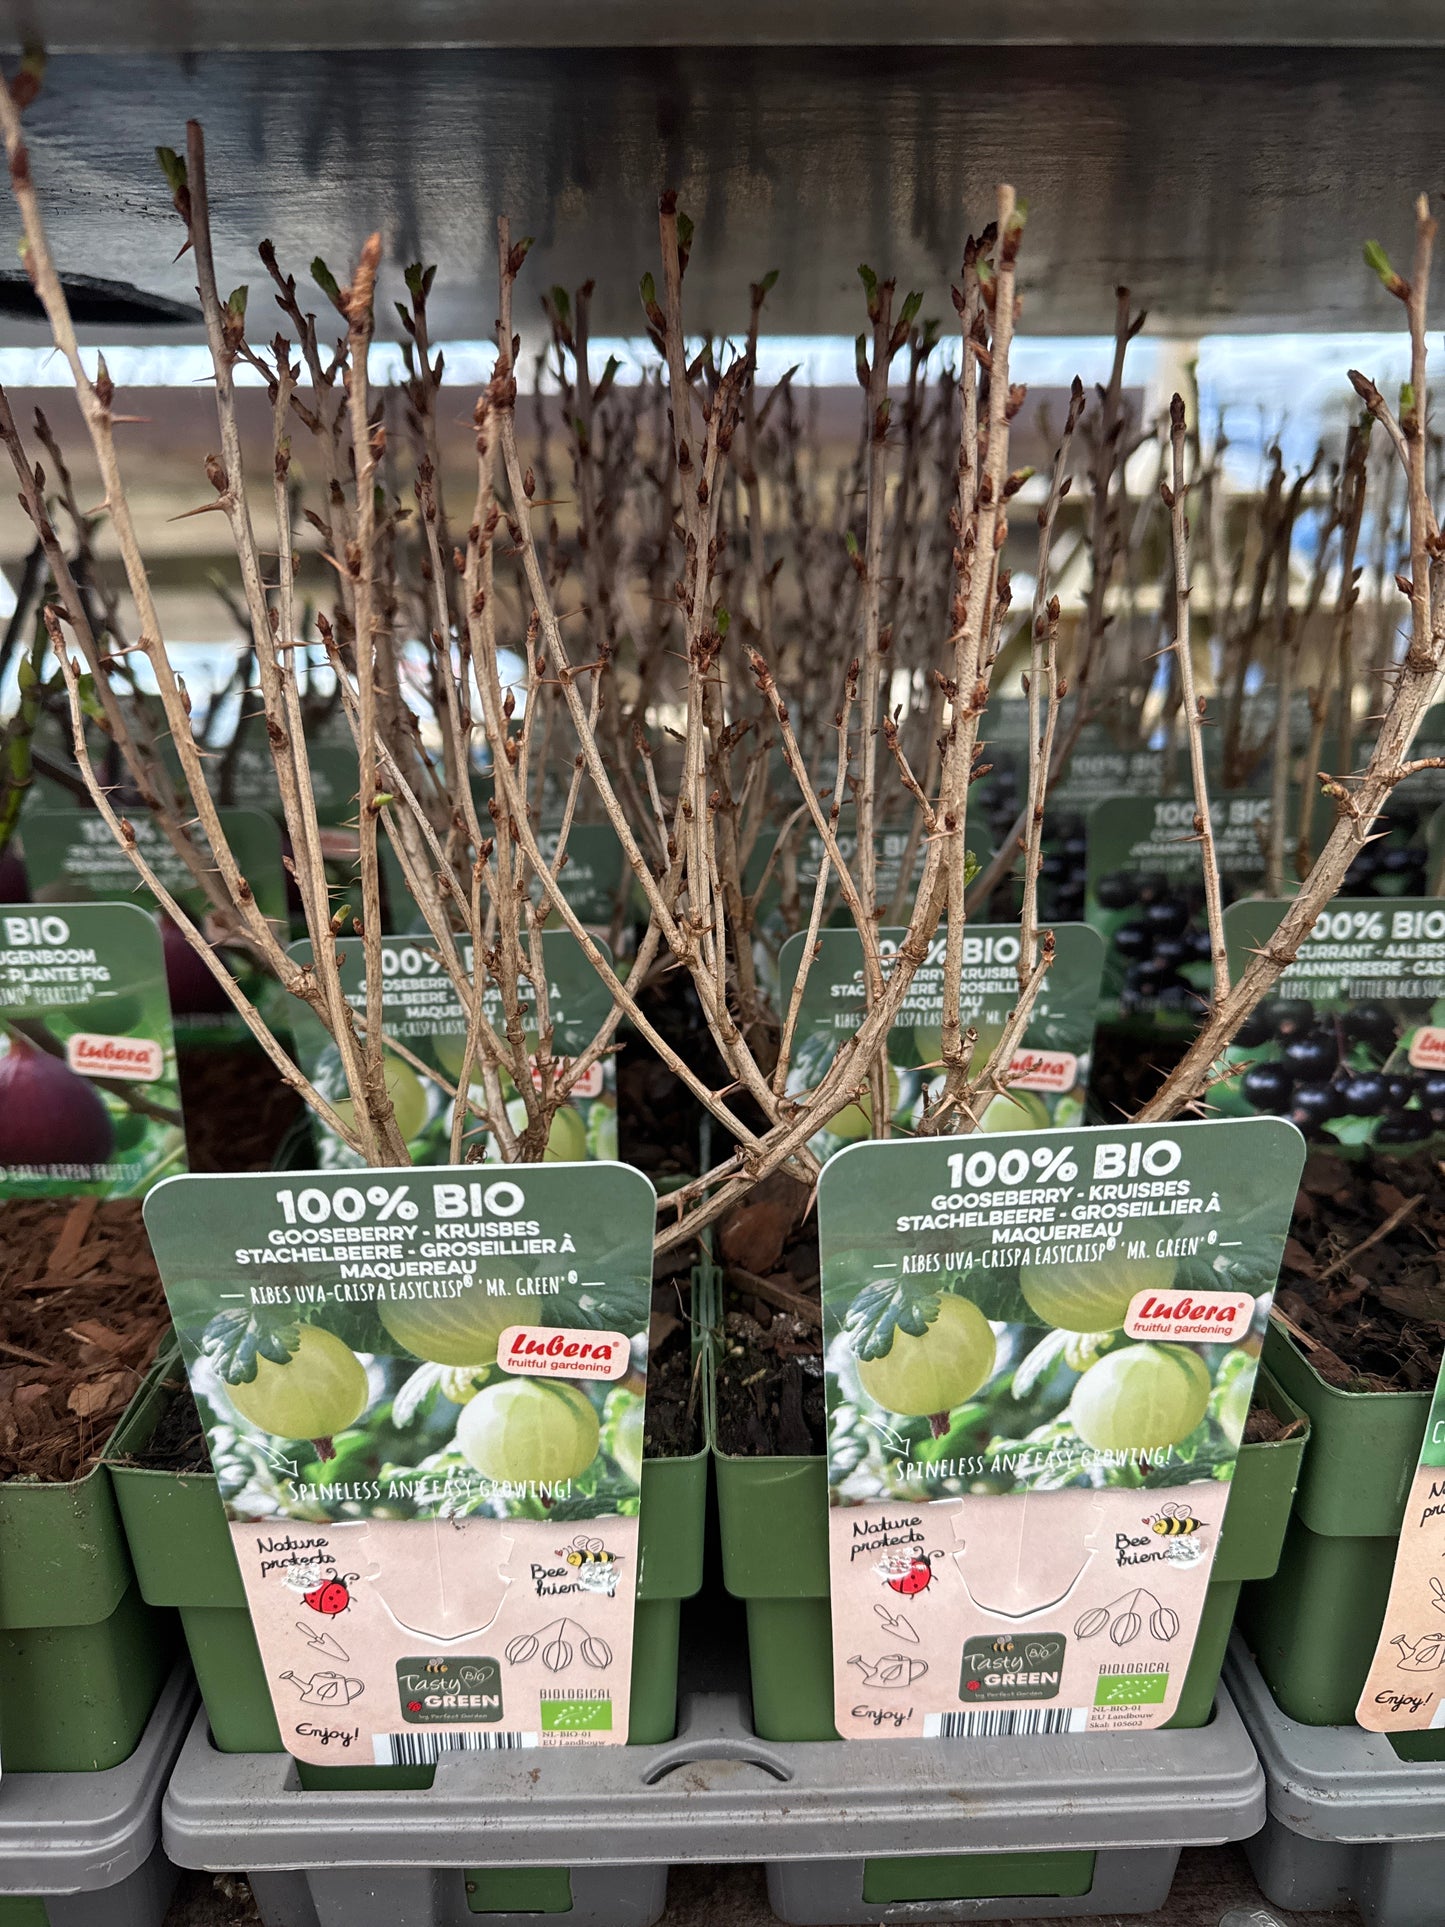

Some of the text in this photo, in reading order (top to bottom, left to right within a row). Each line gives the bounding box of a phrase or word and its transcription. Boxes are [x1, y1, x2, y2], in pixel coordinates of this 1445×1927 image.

[4, 915, 71, 946] BIO
[8, 966, 80, 983] PLANTE
[79, 966, 112, 982] FIG
[946, 1139, 1183, 1189] 100% BIO
[276, 1181, 525, 1224] 100% BIO
[931, 1187, 1073, 1211] GOOSEBERRY
[1088, 1180, 1190, 1201] KRUISBES
[896, 1206, 1055, 1232] STACHELBEERE
[1071, 1198, 1204, 1224] GROSEILLIER
[1204, 1191, 1221, 1213] À
[268, 1224, 419, 1246] GOOSEBERRY
[435, 1220, 540, 1239] KRUISBES
[992, 1221, 1123, 1245] MAQUEREAU
[235, 1243, 403, 1265] STACHELBEERE
[419, 1238, 557, 1259] GROSEILLIER
[559, 1232, 576, 1253] À
[901, 1253, 940, 1274] RIBES
[945, 1244, 1031, 1272] UVA-CRISPA
[340, 1259, 477, 1281] MAQUEREAU
[249, 1285, 291, 1305] RIBES
[295, 1281, 387, 1304] UVA-CRISPA
[1132, 1321, 1233, 1336] fruitful gardening
[507, 1357, 612, 1374] fruitful gardening
[852, 1514, 922, 1538] Nature
[257, 1535, 329, 1554] Nature
[1115, 1533, 1151, 1550] Bee
[530, 1563, 568, 1580] Bee
[964, 1653, 1024, 1674] Tasty
[1099, 1662, 1171, 1675] BIOLOGICAL
[400, 1673, 461, 1696] Tasty
[984, 1671, 1058, 1686] GREEN
[424, 1694, 499, 1708] GREEN
[539, 1688, 612, 1699] BIOLOGICAL
[1374, 1690, 1433, 1713] Enjoy!
[850, 1704, 914, 1727] Enjoy!
[1092, 1705, 1141, 1713] NL-BIO-01
[295, 1722, 359, 1747] Enjoy!
